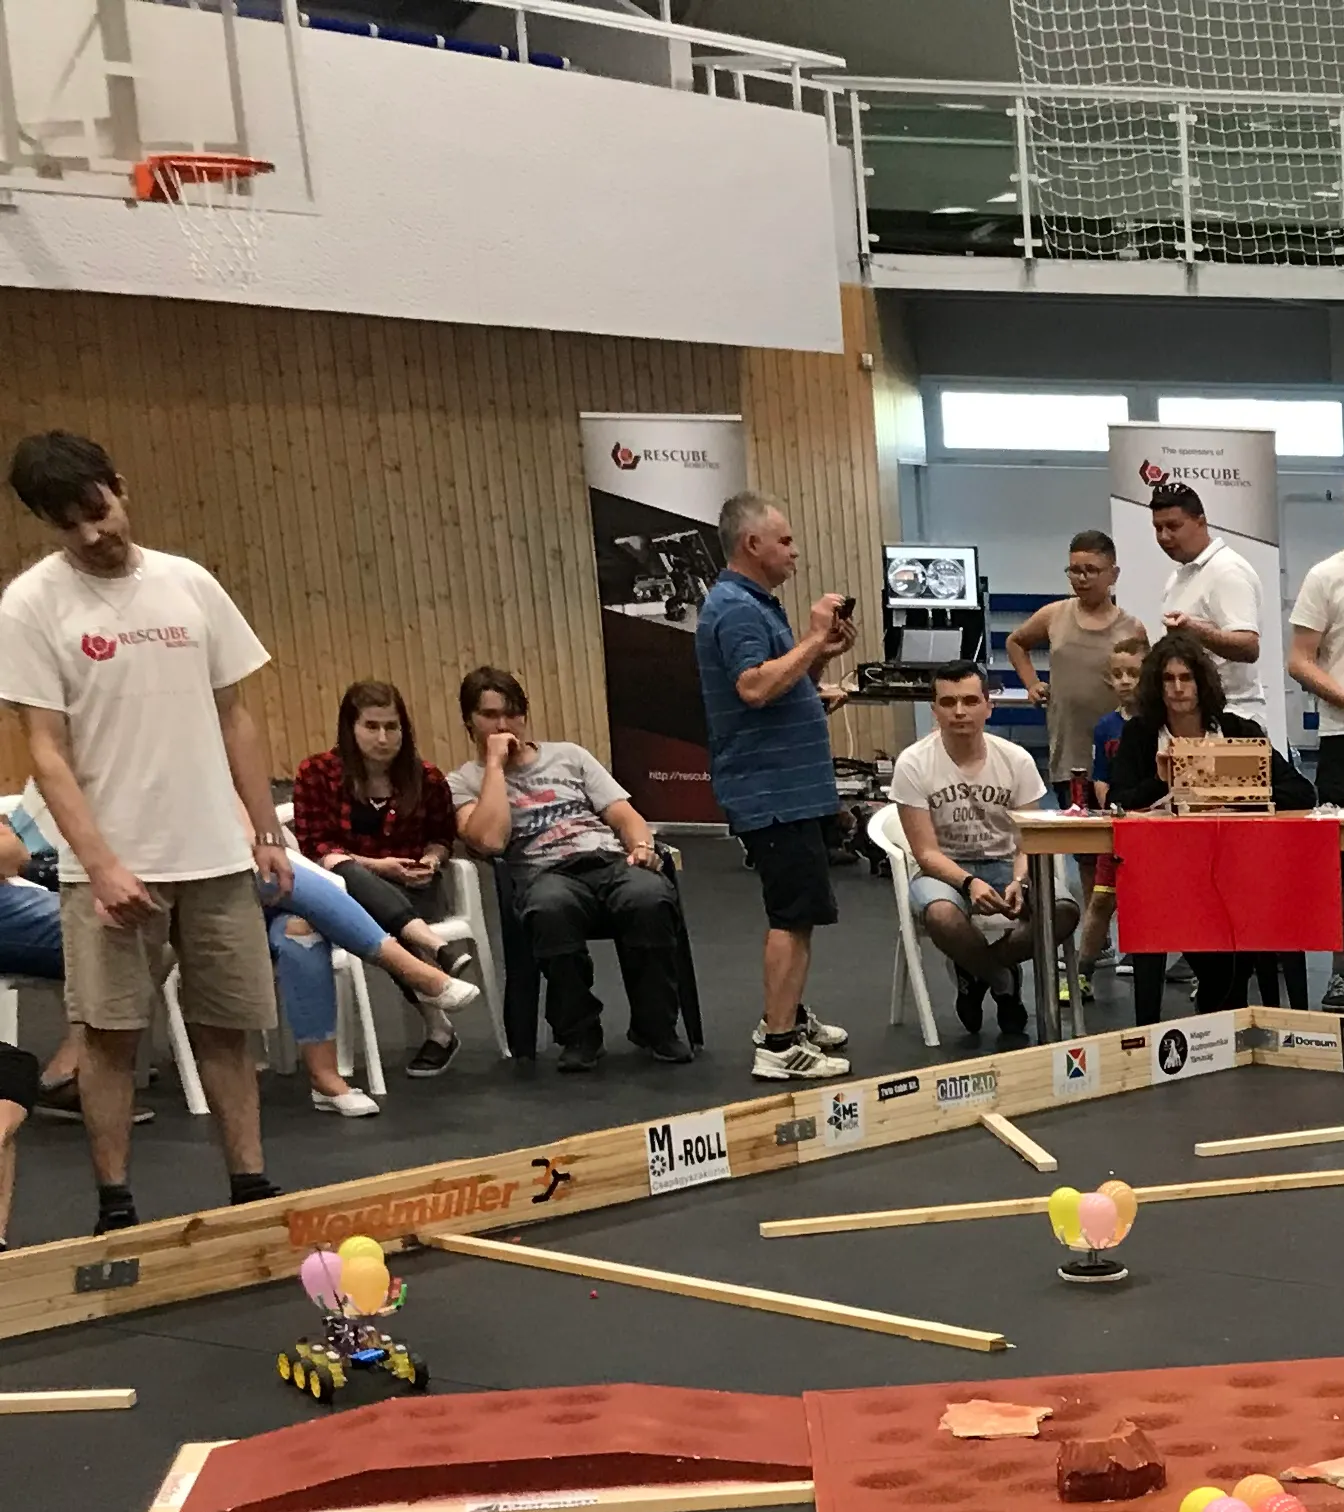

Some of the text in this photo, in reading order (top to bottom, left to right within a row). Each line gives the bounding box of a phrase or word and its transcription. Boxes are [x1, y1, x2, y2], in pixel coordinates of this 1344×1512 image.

[643, 448, 709, 462] RESCUBE
[1172, 467, 1241, 480] RESCUBE
[118, 626, 190, 645] RESCUBE
[927, 782, 1012, 809] CUSTOM
[1295, 1036, 1338, 1048] Dorsum
[842, 1102, 858, 1119] ME
